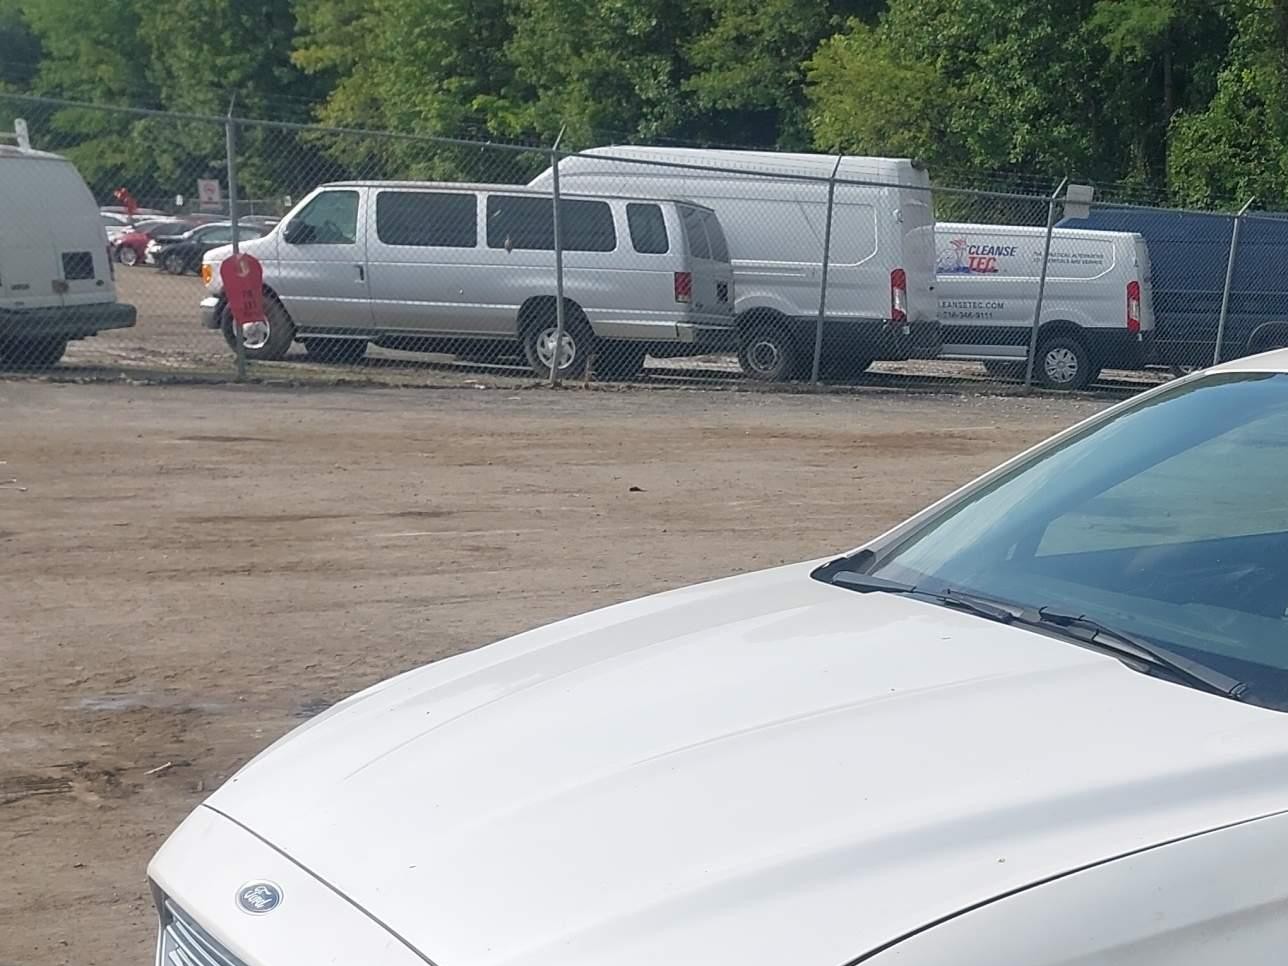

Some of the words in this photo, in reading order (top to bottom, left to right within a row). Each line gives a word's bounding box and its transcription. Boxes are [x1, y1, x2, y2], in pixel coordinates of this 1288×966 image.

[968, 245, 1018, 256] CLEANSE
[968, 256, 998, 273] TEC
[243, 885, 273, 909] Ford
